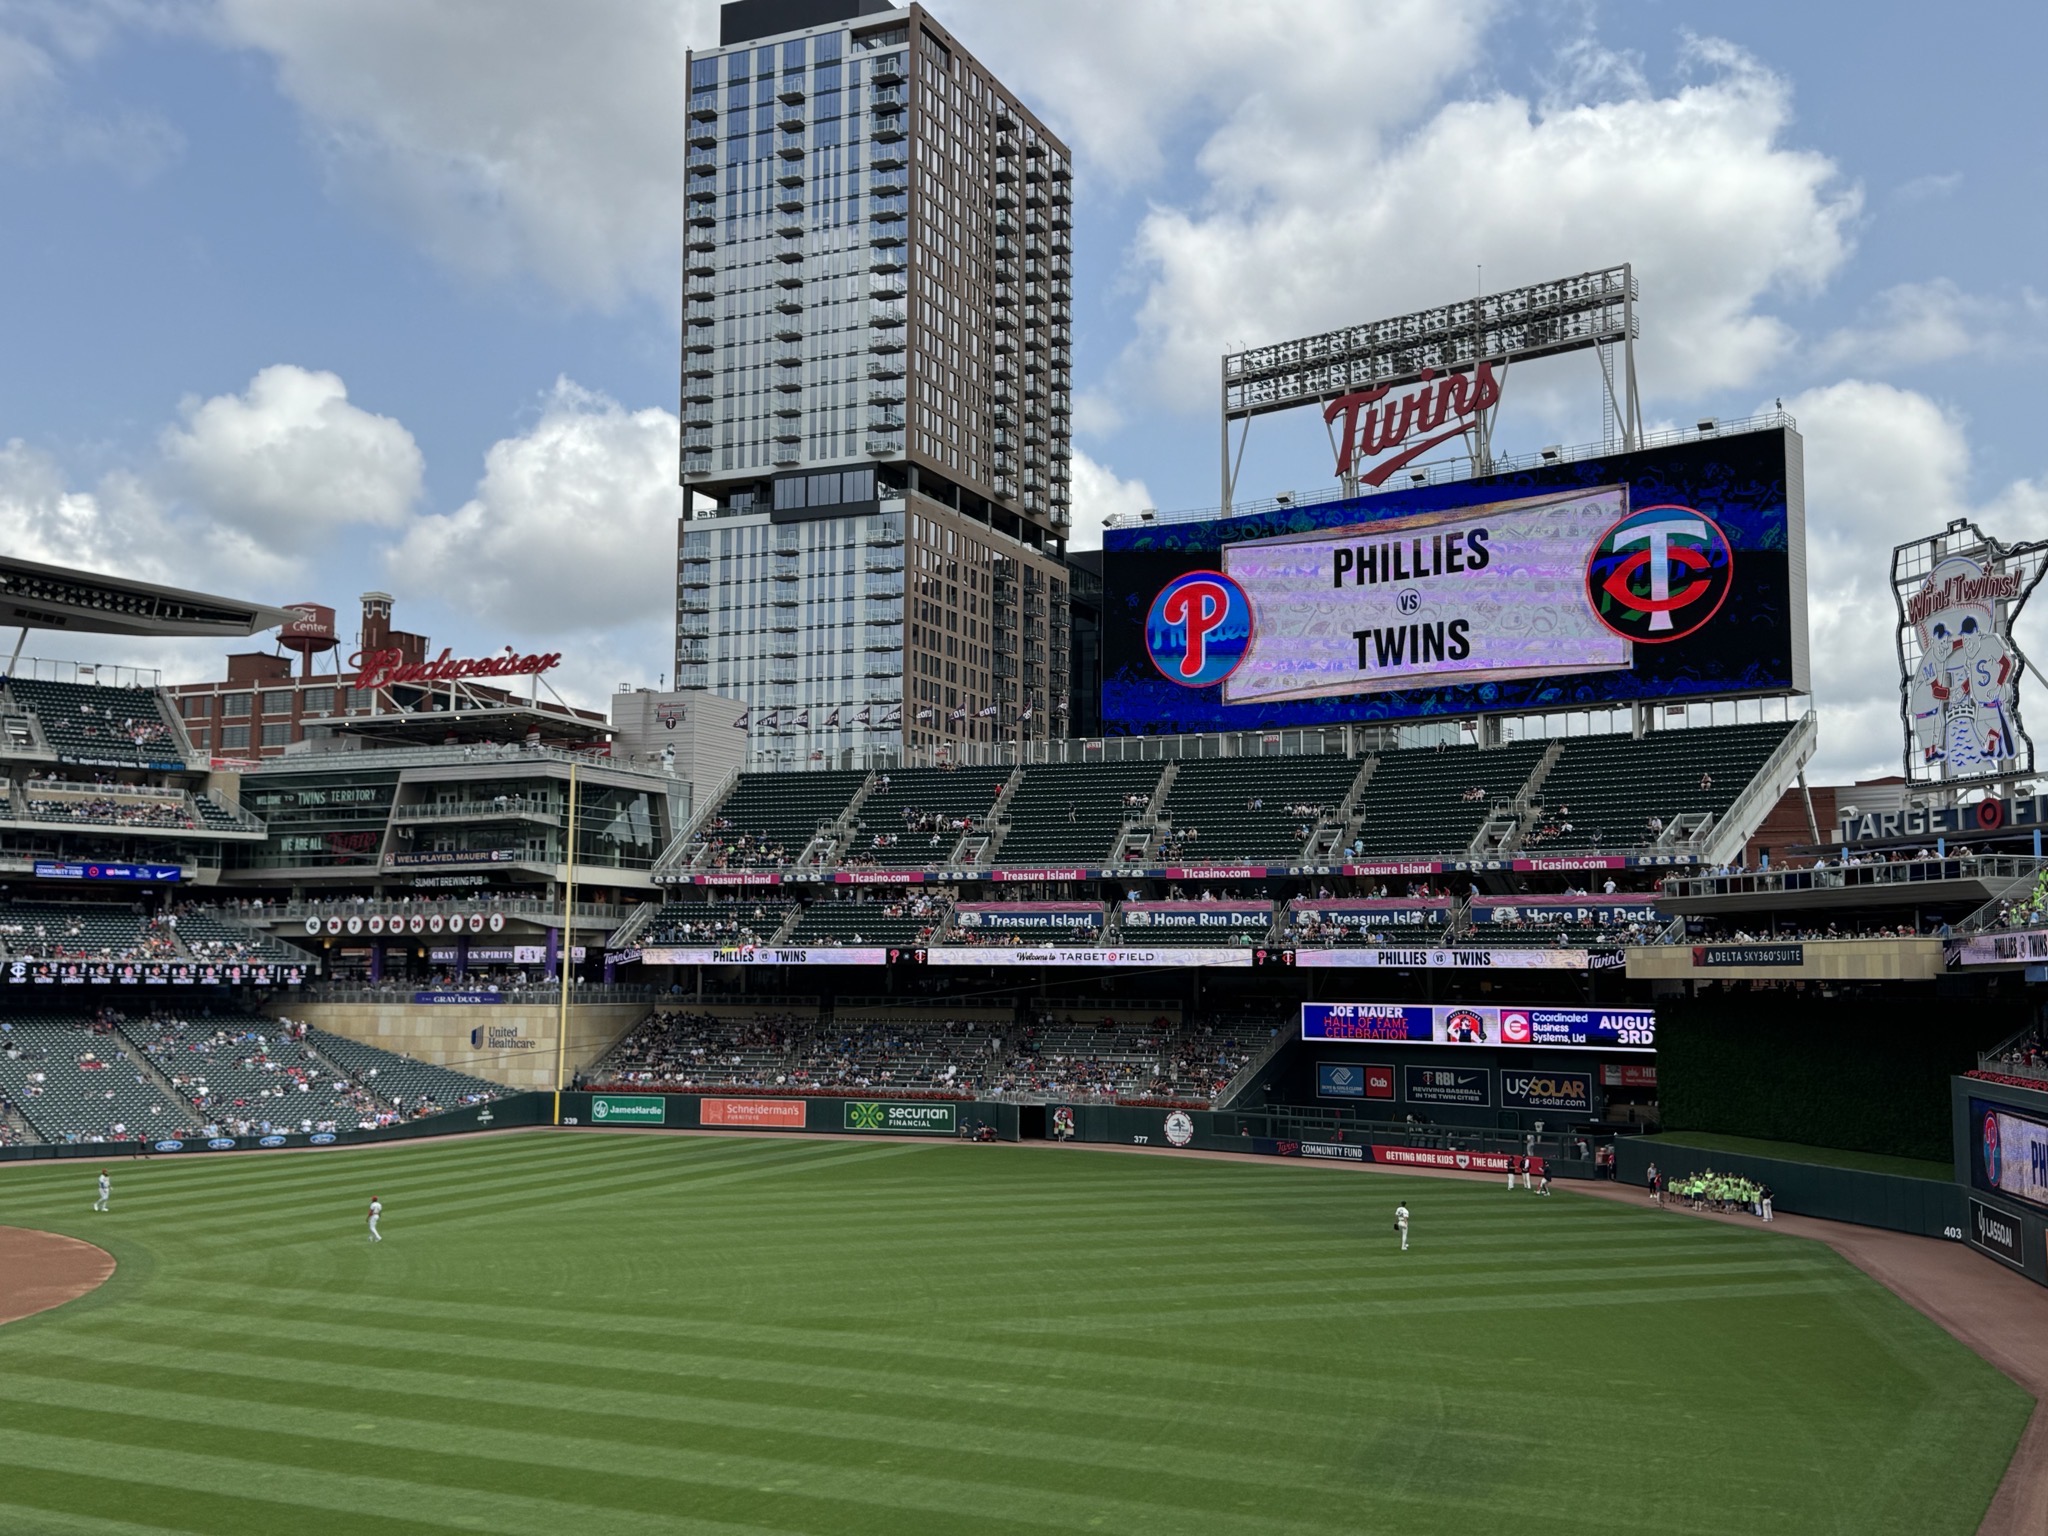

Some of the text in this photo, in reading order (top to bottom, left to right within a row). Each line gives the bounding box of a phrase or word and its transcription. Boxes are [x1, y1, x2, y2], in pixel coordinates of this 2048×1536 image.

[1323, 362, 1499, 478] Twins
[1334, 528, 1489, 588] PHILLIES
[1400, 594, 1418, 611] VS
[1906, 567, 2024, 627] Win! Twins!
[292, 621, 327, 632] Center
[1353, 619, 1470, 670] TWINS
[348, 645, 561, 690] Budweiser
[298, 792, 326, 806] TWINS
[331, 789, 377, 803] TERRITORY
[1840, 804, 1970, 842] TARGET
[281, 837, 322, 852] WE ARE ALL
[397, 855, 419, 864] WELL
[420, 854, 455, 863] PLAYED,
[456, 853, 489, 862] MAUER!
[1353, 863, 1432, 875] Treasure Island
[704, 874, 772, 885] Treasure Island
[1002, 870, 1077, 881] Treasure Island
[415, 876, 483, 888] SUMMIT BREWING PUB
[988, 913, 1092, 927] Treasure Island
[1155, 912, 1268, 926] Home Run Deck
[1329, 912, 1390, 925] Treasure
[431, 950, 513, 960] GRAY SPIRITS
[713, 950, 754, 962] PHILLIES
[775, 950, 806, 962] TWINS
[1017, 952, 1048, 961] Welcome
[1060, 952, 1107, 961] TARGET
[1119, 952, 1155, 961] FIELD
[1378, 951, 1427, 965] PHILLIES
[1452, 951, 1491, 966] TWINS
[1715, 951, 1742, 962] DELTA
[433, 996, 458, 1004] GRAY
[1329, 1006, 1403, 1018] JOE MAUER
[1532, 1012, 1588, 1023] Coordinated
[1324, 1017, 1409, 1029] HALL OF FAME
[1533, 1023, 1569, 1032] Business
[488, 1026, 518, 1038] United
[1325, 1027, 1407, 1040] CELEBRATION
[1532, 1032, 1586, 1044] Systems, Ltd
[1618, 1030, 1654, 1044] 3RD
[488, 1037, 536, 1049] Healthcare
[1370, 1077, 1388, 1088] Cub
[1435, 1072, 1455, 1086] RBI
[1446, 1088, 1482, 1096] BASEBALL
[1529, 1097, 1586, 1107] us-solar.com
[610, 1105, 662, 1115] JamesHardie
[726, 1104, 799, 1116] Schneiderman's
[888, 1108, 948, 1120] securian
[563, 1117, 578, 1125] 339
[888, 1119, 931, 1127] FINANCIAL
[1133, 1135, 1149, 1144] 377
[1301, 1144, 1363, 1157] COMMUNITY FUND
[1386, 1151, 1454, 1165] GETTING MORE KIDS
[1472, 1157, 1508, 1169] THE GAME
[1944, 1226, 1962, 1239] 403
